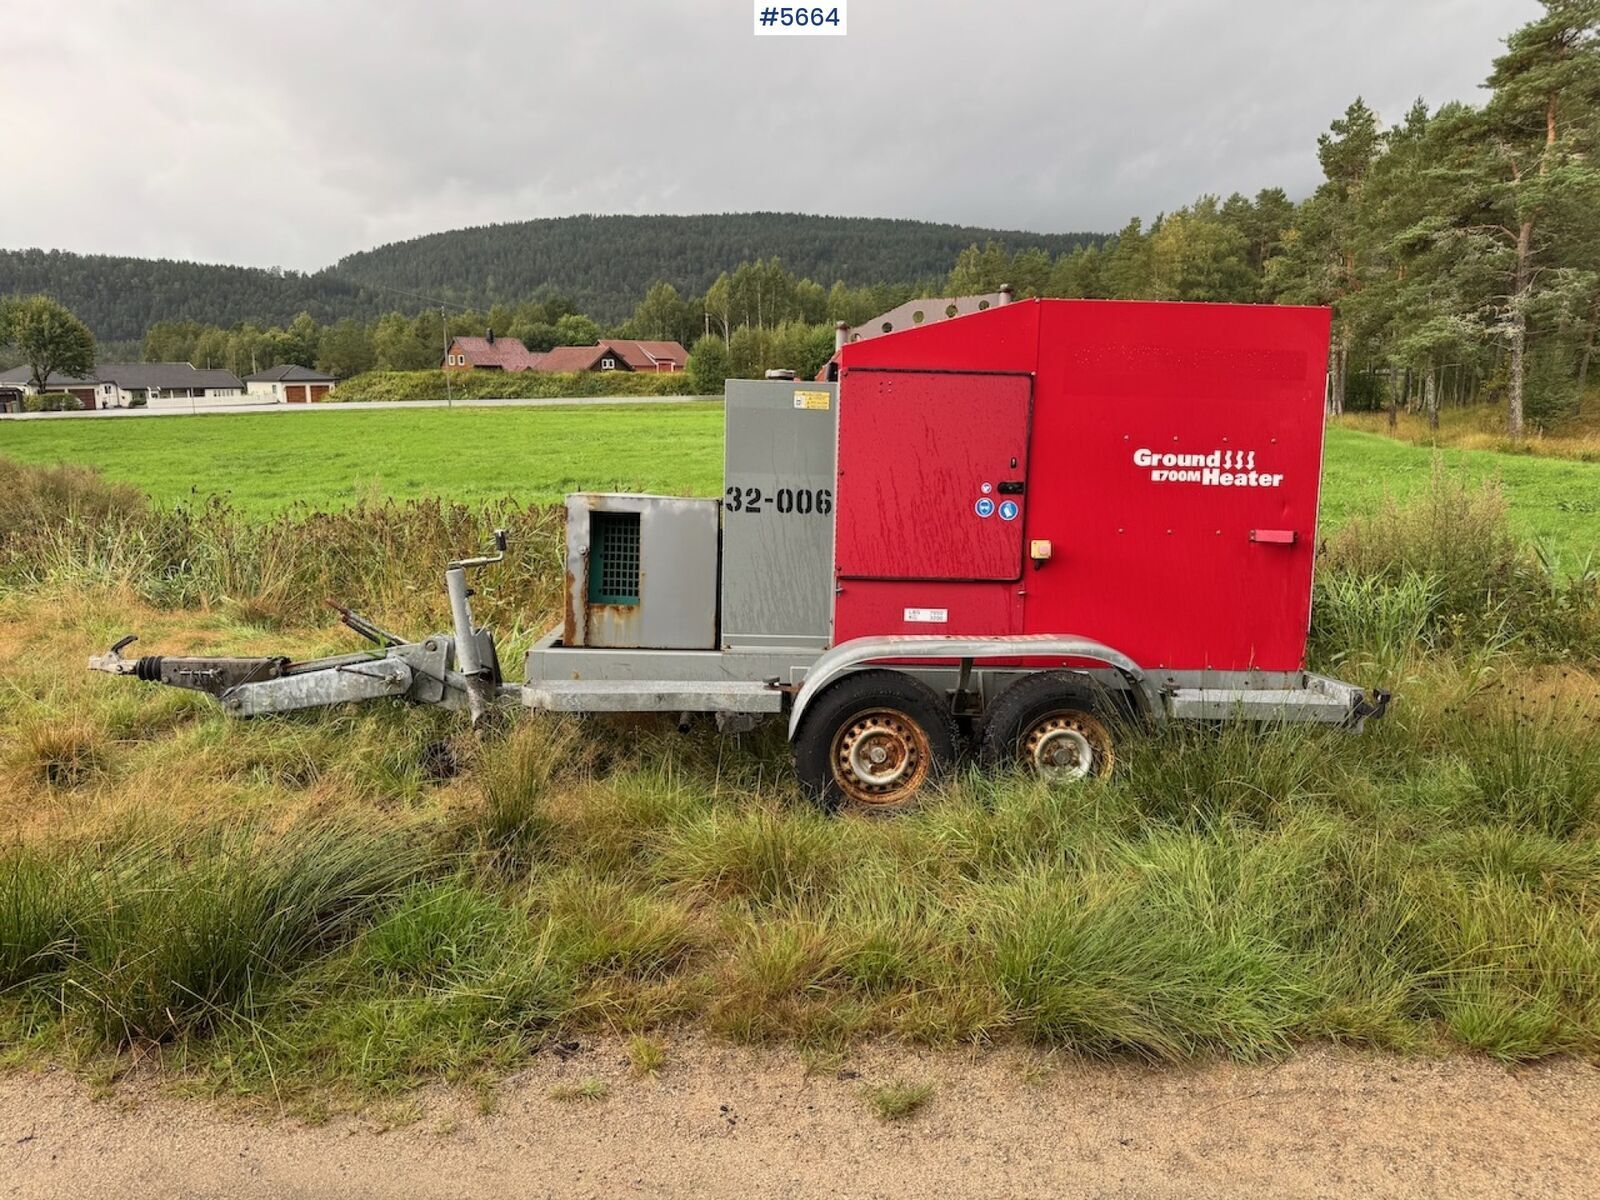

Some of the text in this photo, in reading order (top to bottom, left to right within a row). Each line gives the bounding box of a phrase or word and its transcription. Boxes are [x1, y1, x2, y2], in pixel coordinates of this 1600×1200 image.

[1133, 448, 1221, 467] Ground
[1202, 467, 1284, 486] Heater
[725, 486, 832, 515] 32-006
